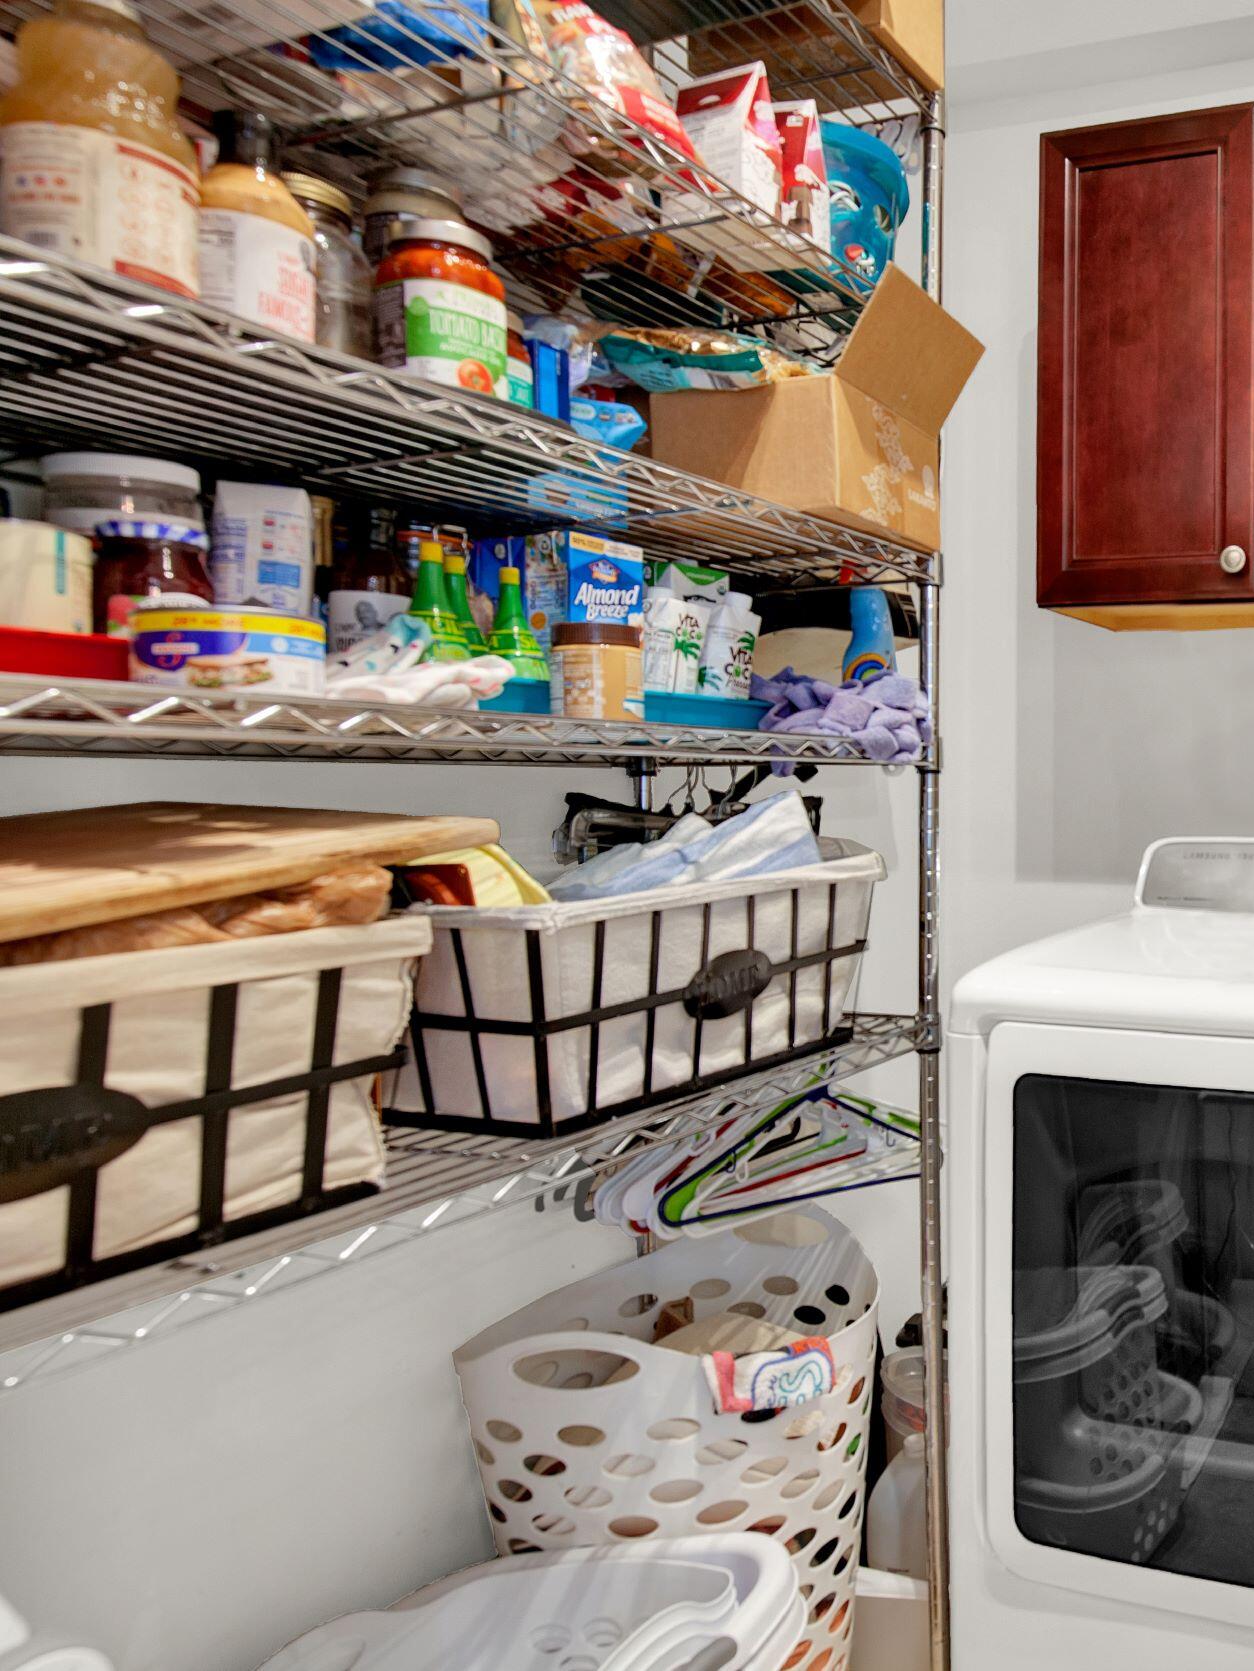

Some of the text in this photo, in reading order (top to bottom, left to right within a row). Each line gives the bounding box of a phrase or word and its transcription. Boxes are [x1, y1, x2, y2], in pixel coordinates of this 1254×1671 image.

[574, 582, 640, 606] Almond
[586, 604, 629, 621] Breeze
[679, 613, 700, 629] VITA
[729, 645, 752, 666] VITA
[724, 663, 750, 680] COC
